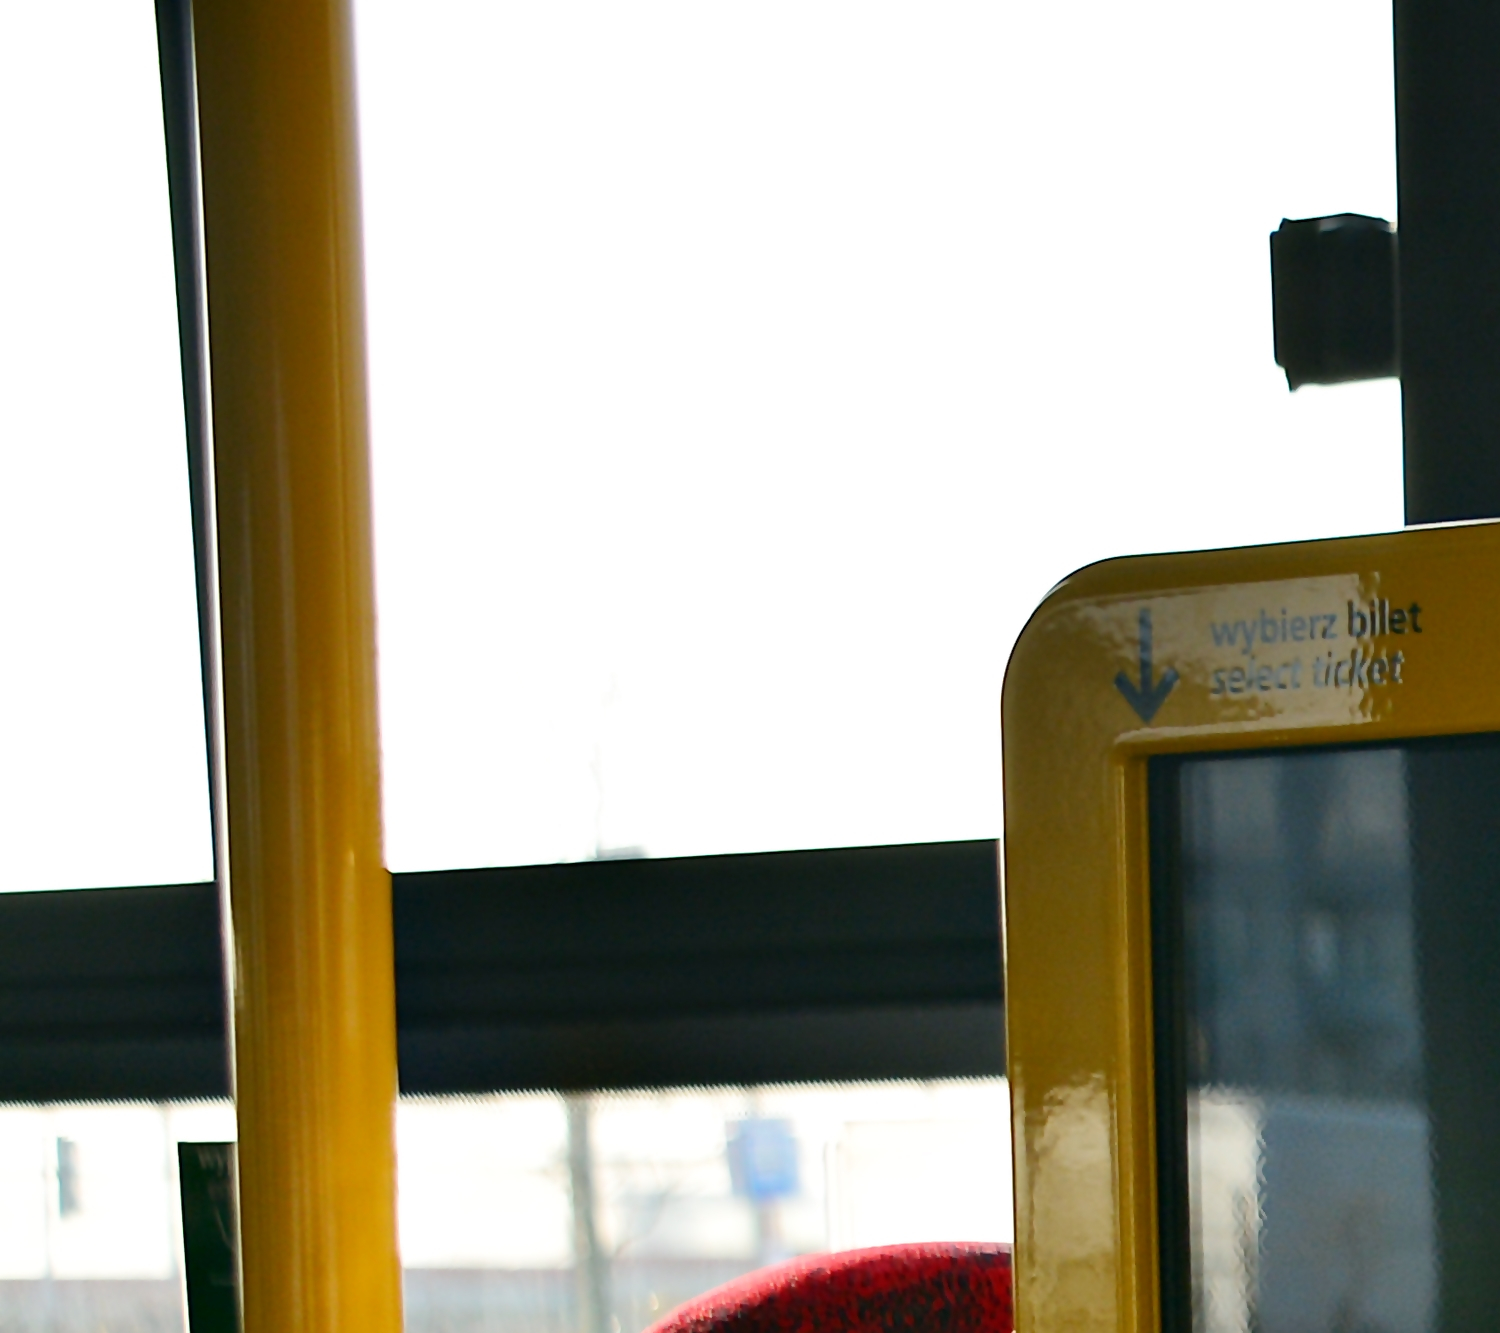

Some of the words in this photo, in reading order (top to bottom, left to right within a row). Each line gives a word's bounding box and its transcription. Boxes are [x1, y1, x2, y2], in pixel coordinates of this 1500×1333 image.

[1210, 608, 1337, 655] wybierz
[1347, 599, 1423, 638] bilet
[1211, 656, 1301, 695] select
[1312, 650, 1406, 689] ticket
